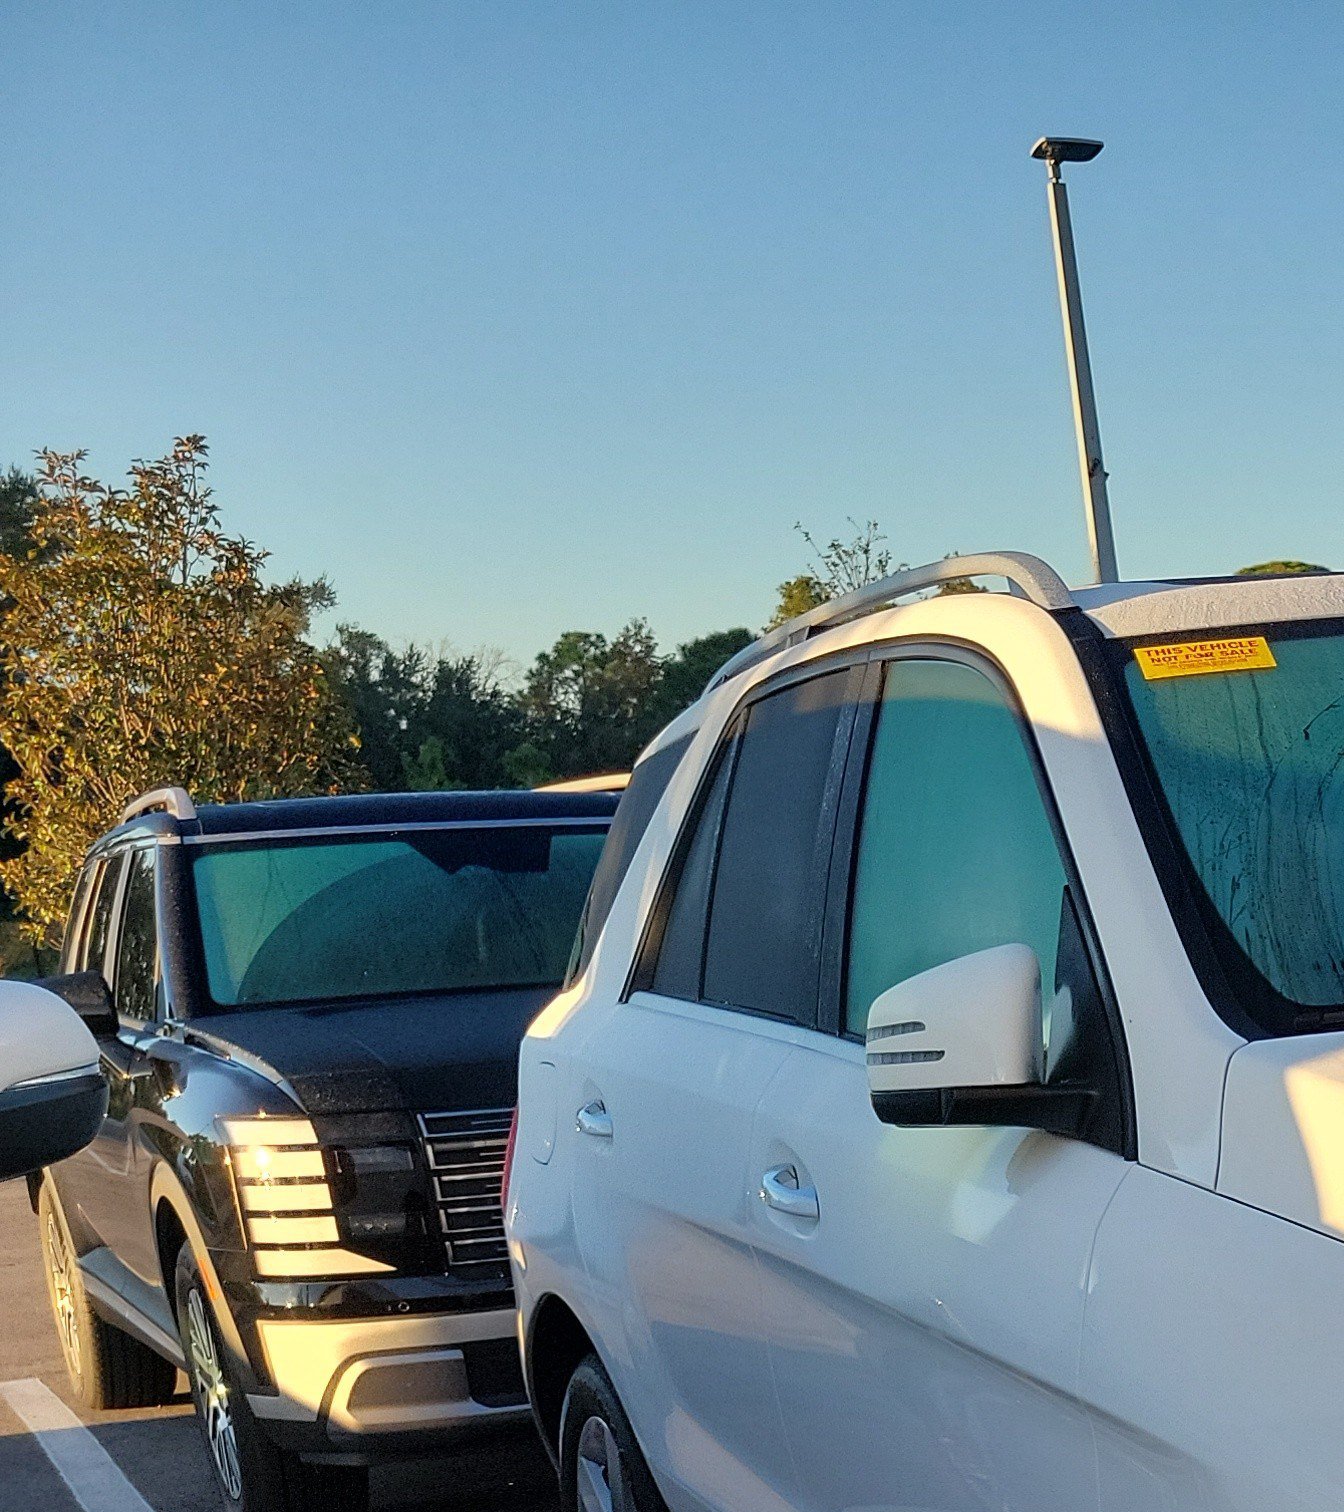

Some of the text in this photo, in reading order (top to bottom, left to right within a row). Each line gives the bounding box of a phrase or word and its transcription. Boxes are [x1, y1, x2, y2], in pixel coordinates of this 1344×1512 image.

[1145, 640, 1260, 657] THIS VEHICLE
[1150, 655, 1179, 664] NOT
[1185, 652, 1215, 661] FOR
[1220, 648, 1259, 657] SALE
